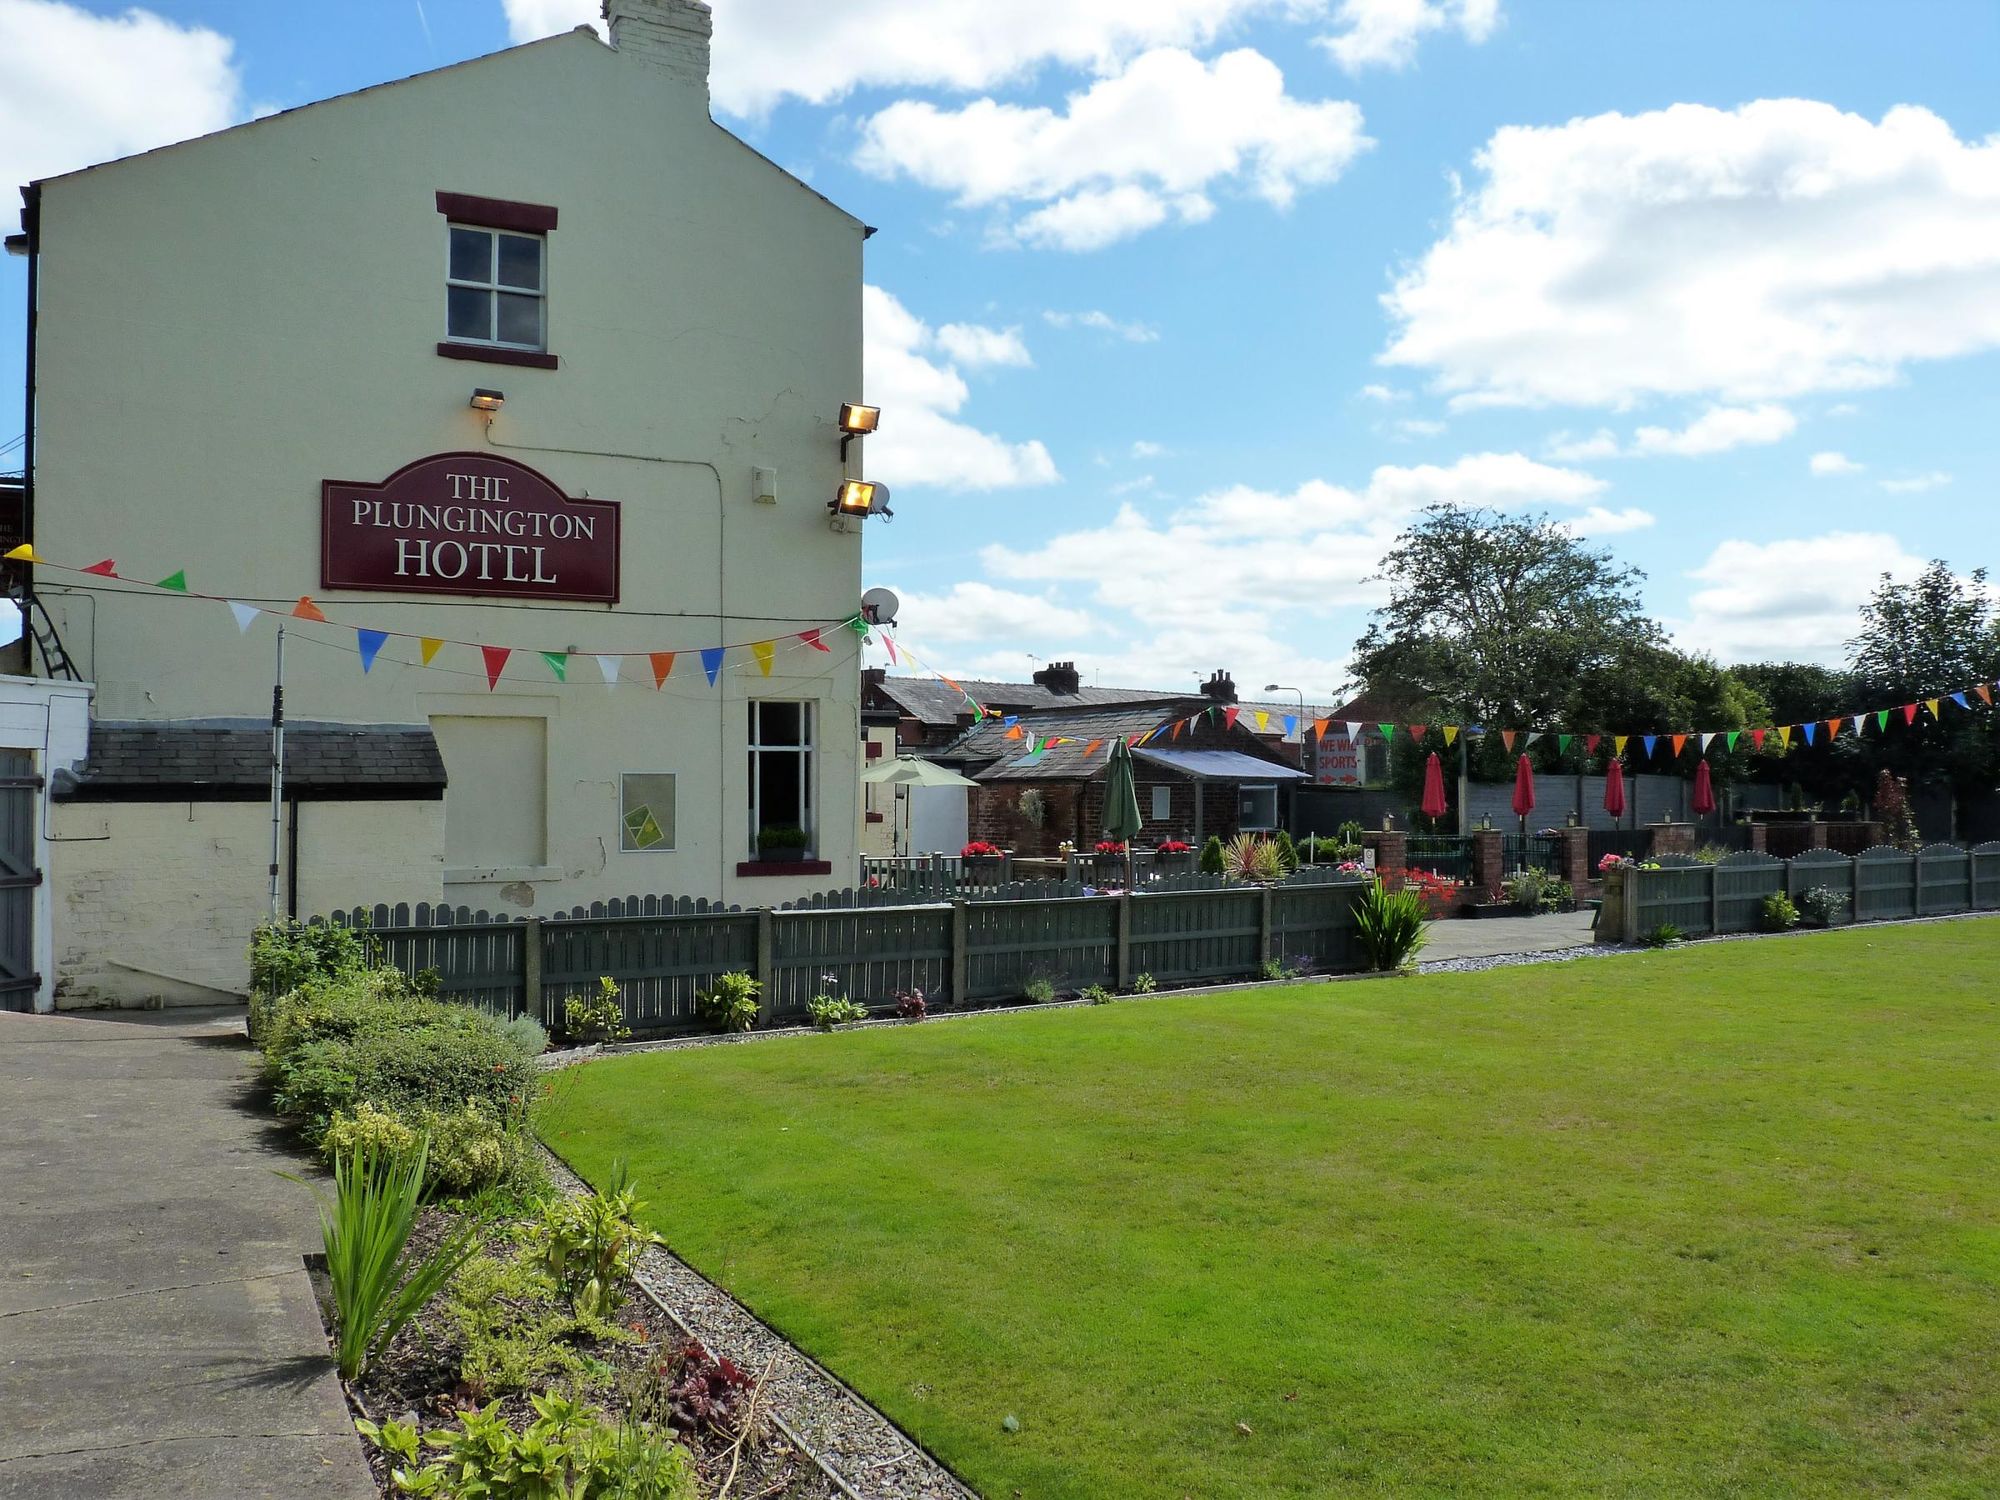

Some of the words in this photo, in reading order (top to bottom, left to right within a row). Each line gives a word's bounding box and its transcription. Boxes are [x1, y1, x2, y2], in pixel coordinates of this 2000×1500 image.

[446, 473, 510, 502] THE
[352, 500, 595, 540] PLUNGINGTON
[394, 538, 557, 584] HOTEL
[1319, 756, 1357, 769] SPORTS
